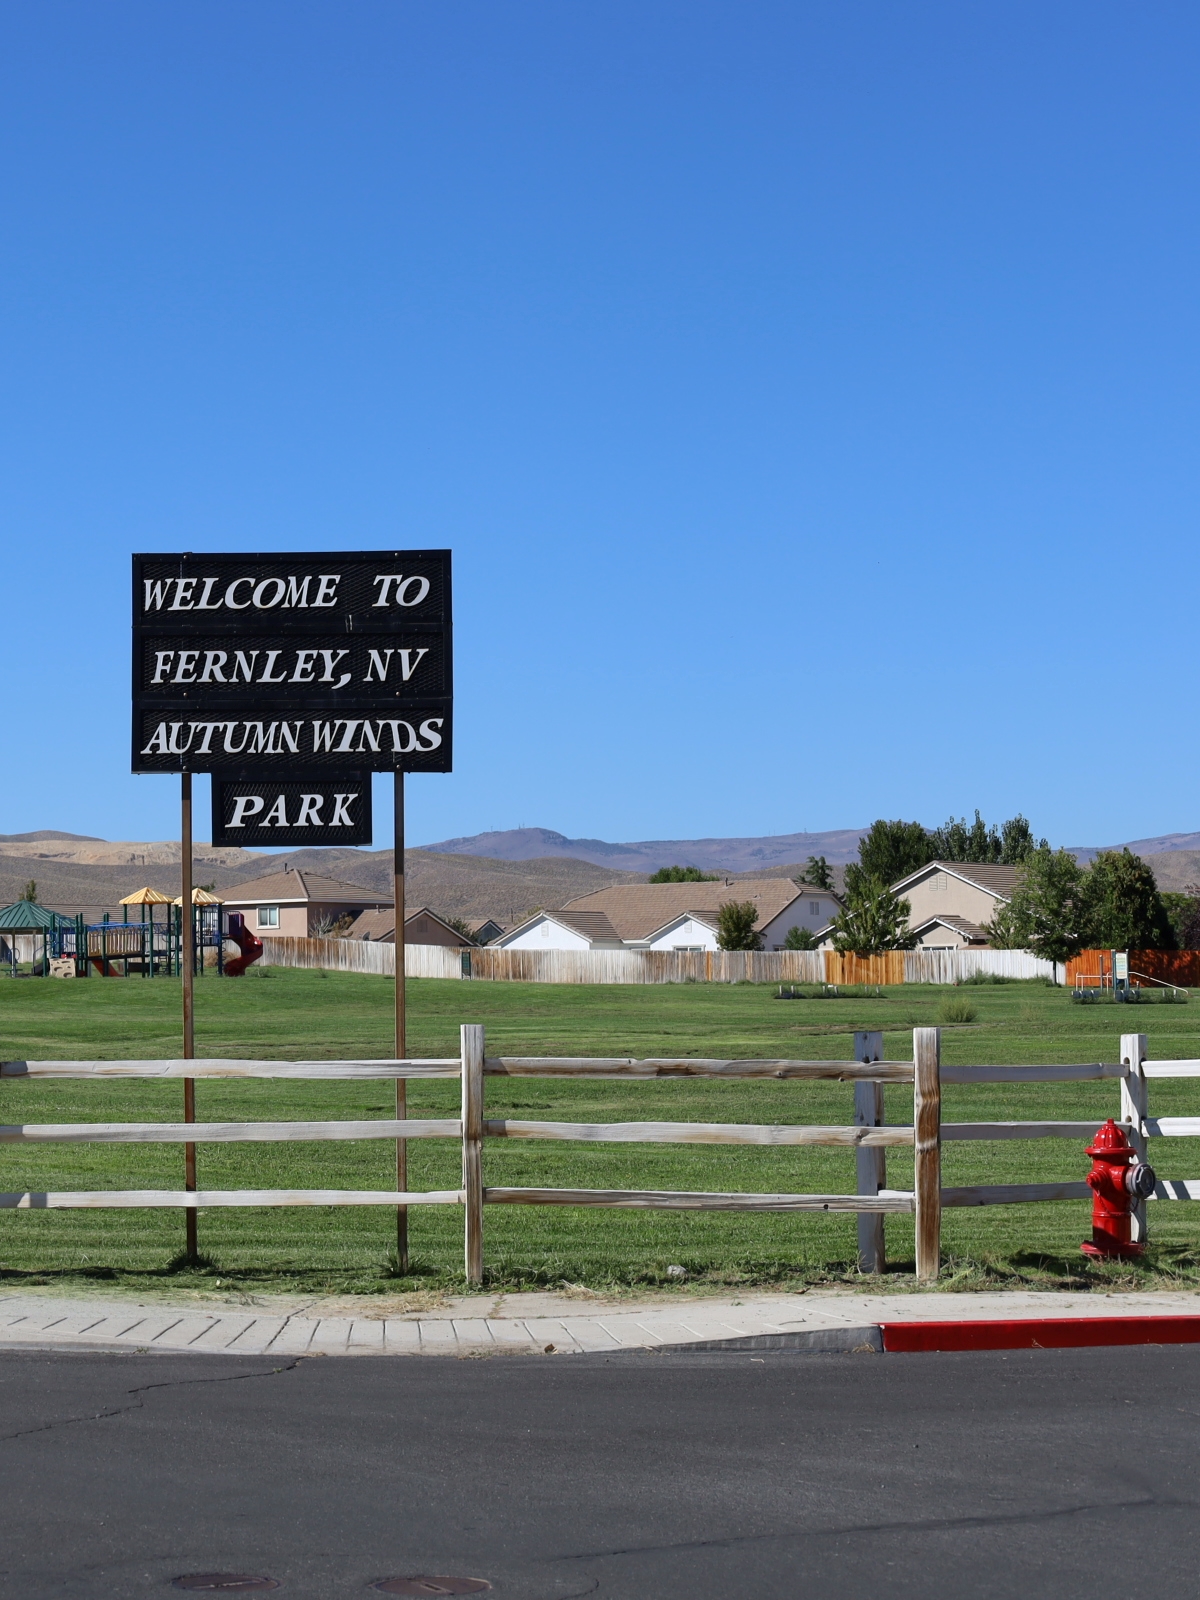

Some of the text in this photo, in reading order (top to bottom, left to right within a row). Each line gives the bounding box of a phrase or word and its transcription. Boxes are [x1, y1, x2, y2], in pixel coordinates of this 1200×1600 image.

[143, 574, 430, 611] WELCOME TO
[150, 648, 430, 690] FERNLEY, NV
[140, 718, 444, 754] AUTUMN WINDS
[225, 793, 359, 828] PARK
